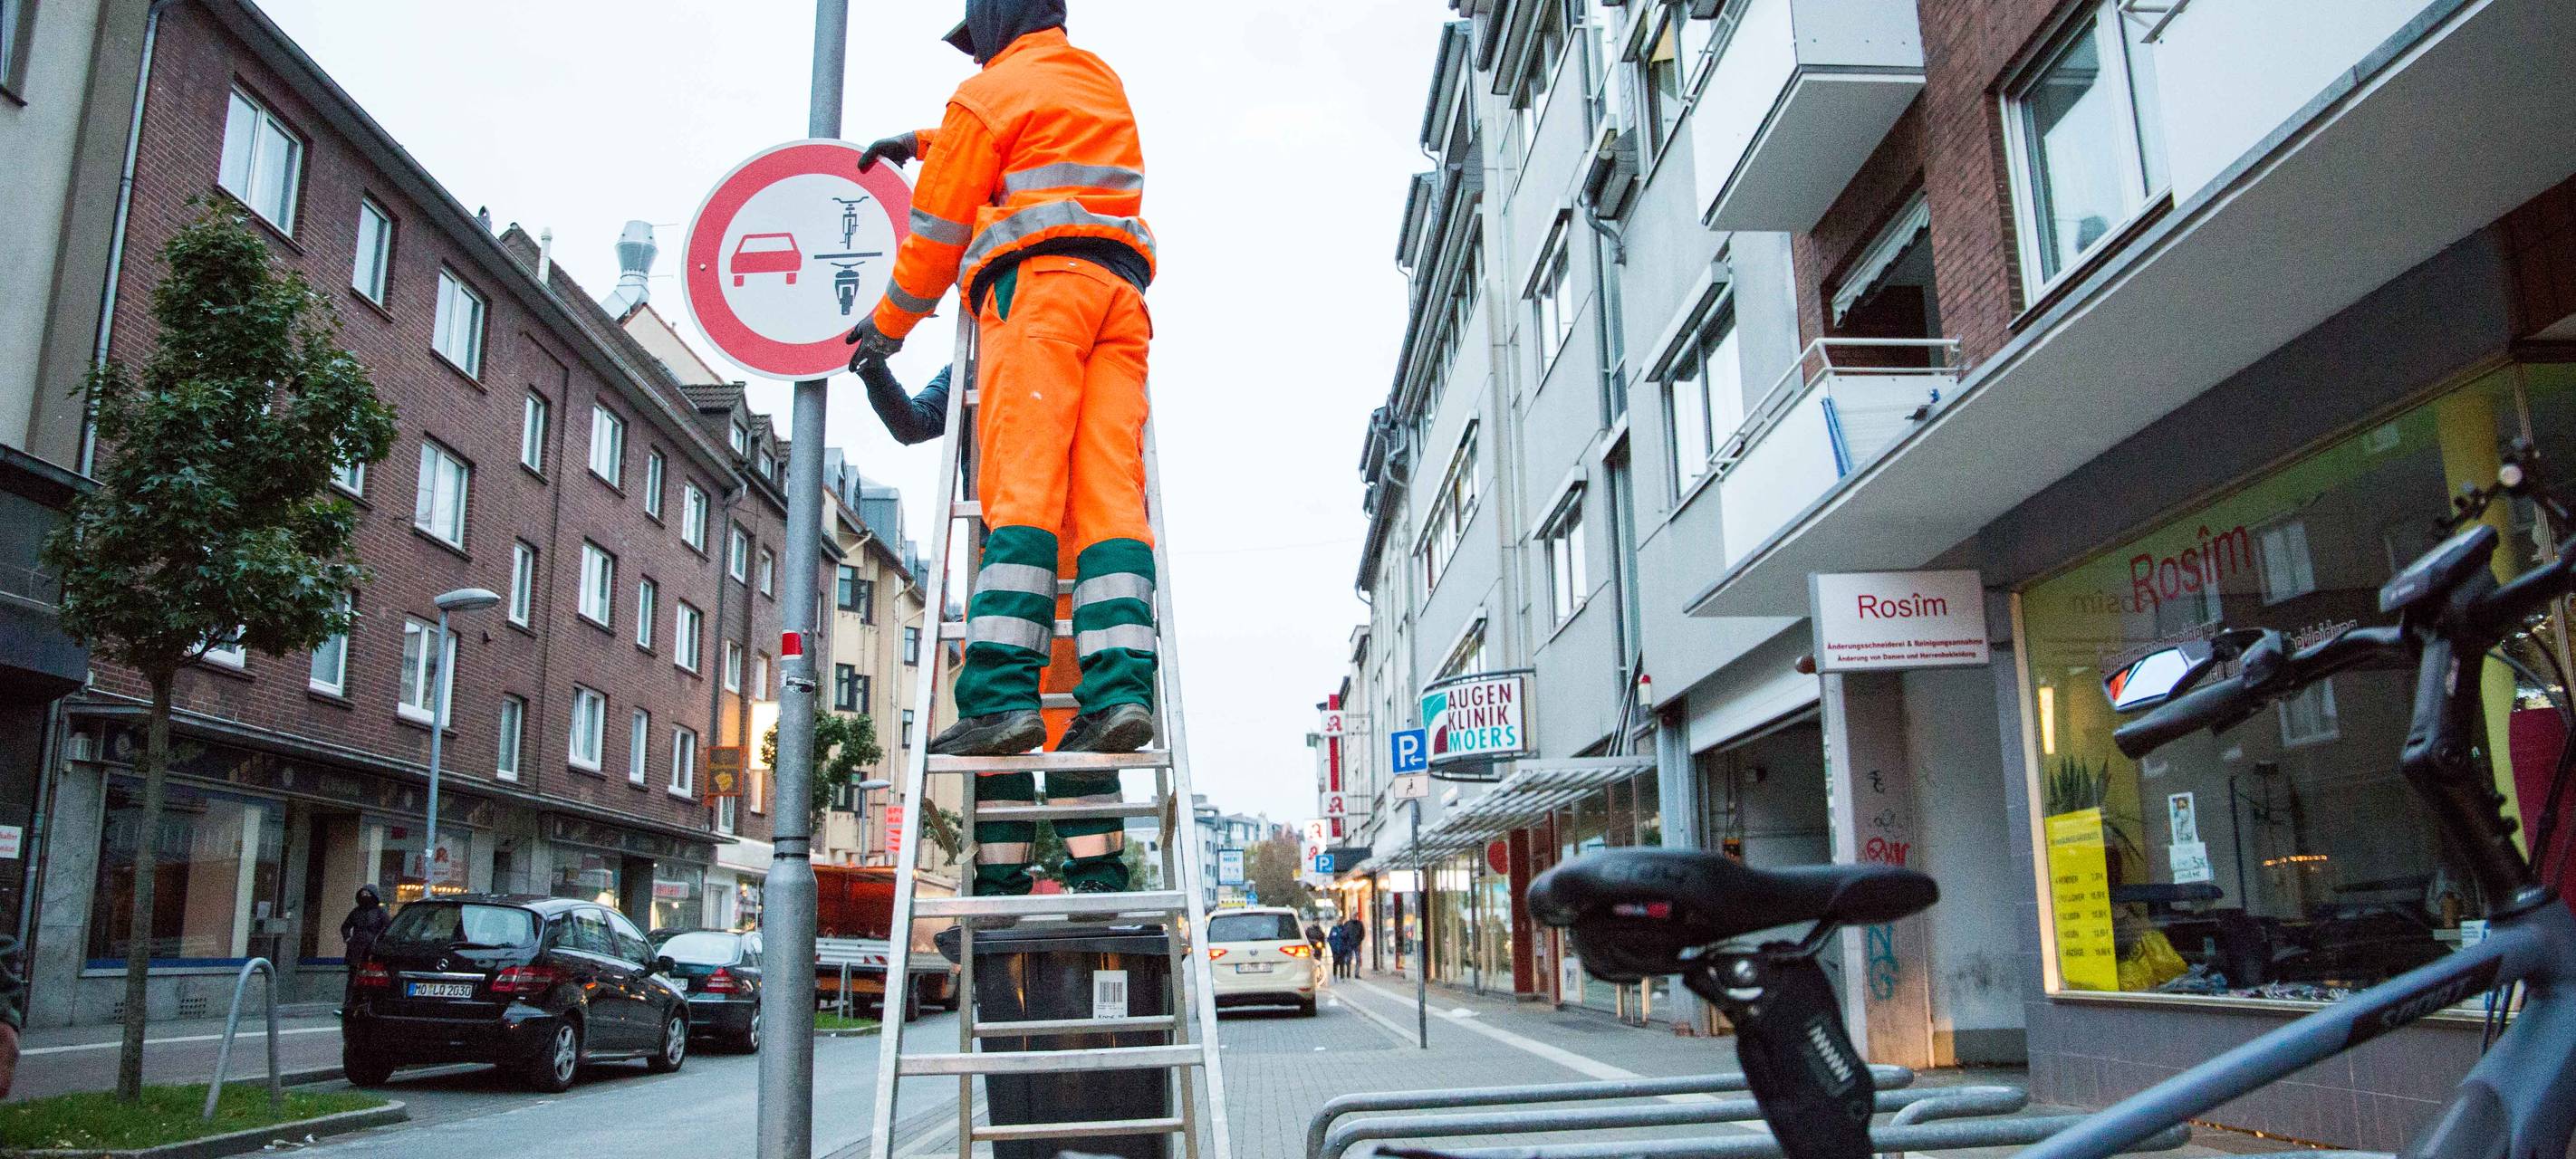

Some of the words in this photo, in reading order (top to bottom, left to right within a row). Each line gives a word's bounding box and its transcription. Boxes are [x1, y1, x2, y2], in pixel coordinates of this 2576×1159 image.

[2130, 524, 2253, 615] Rosîm
[1858, 592, 1947, 619] Rosîm
[1827, 640, 1906, 651] Änderungsschneiderei
[1908, 639, 1913, 647] &
[1914, 638, 1984, 648] Reinigungsannahme
[1837, 654, 1869, 663] Änderung
[1883, 652, 1905, 661] Damen
[1907, 652, 1919, 660] und
[1920, 650, 1977, 661] Herrenbekleidung
[1448, 683, 1513, 711] AUGEN
[1448, 705, 1510, 732] KLINIK
[1399, 735, 1419, 768] P
[1449, 725, 1516, 753] MOERS
[1320, 856, 1330, 871] P
[415, 984, 427, 995] MO
[447, 985, 472, 997] 2030
